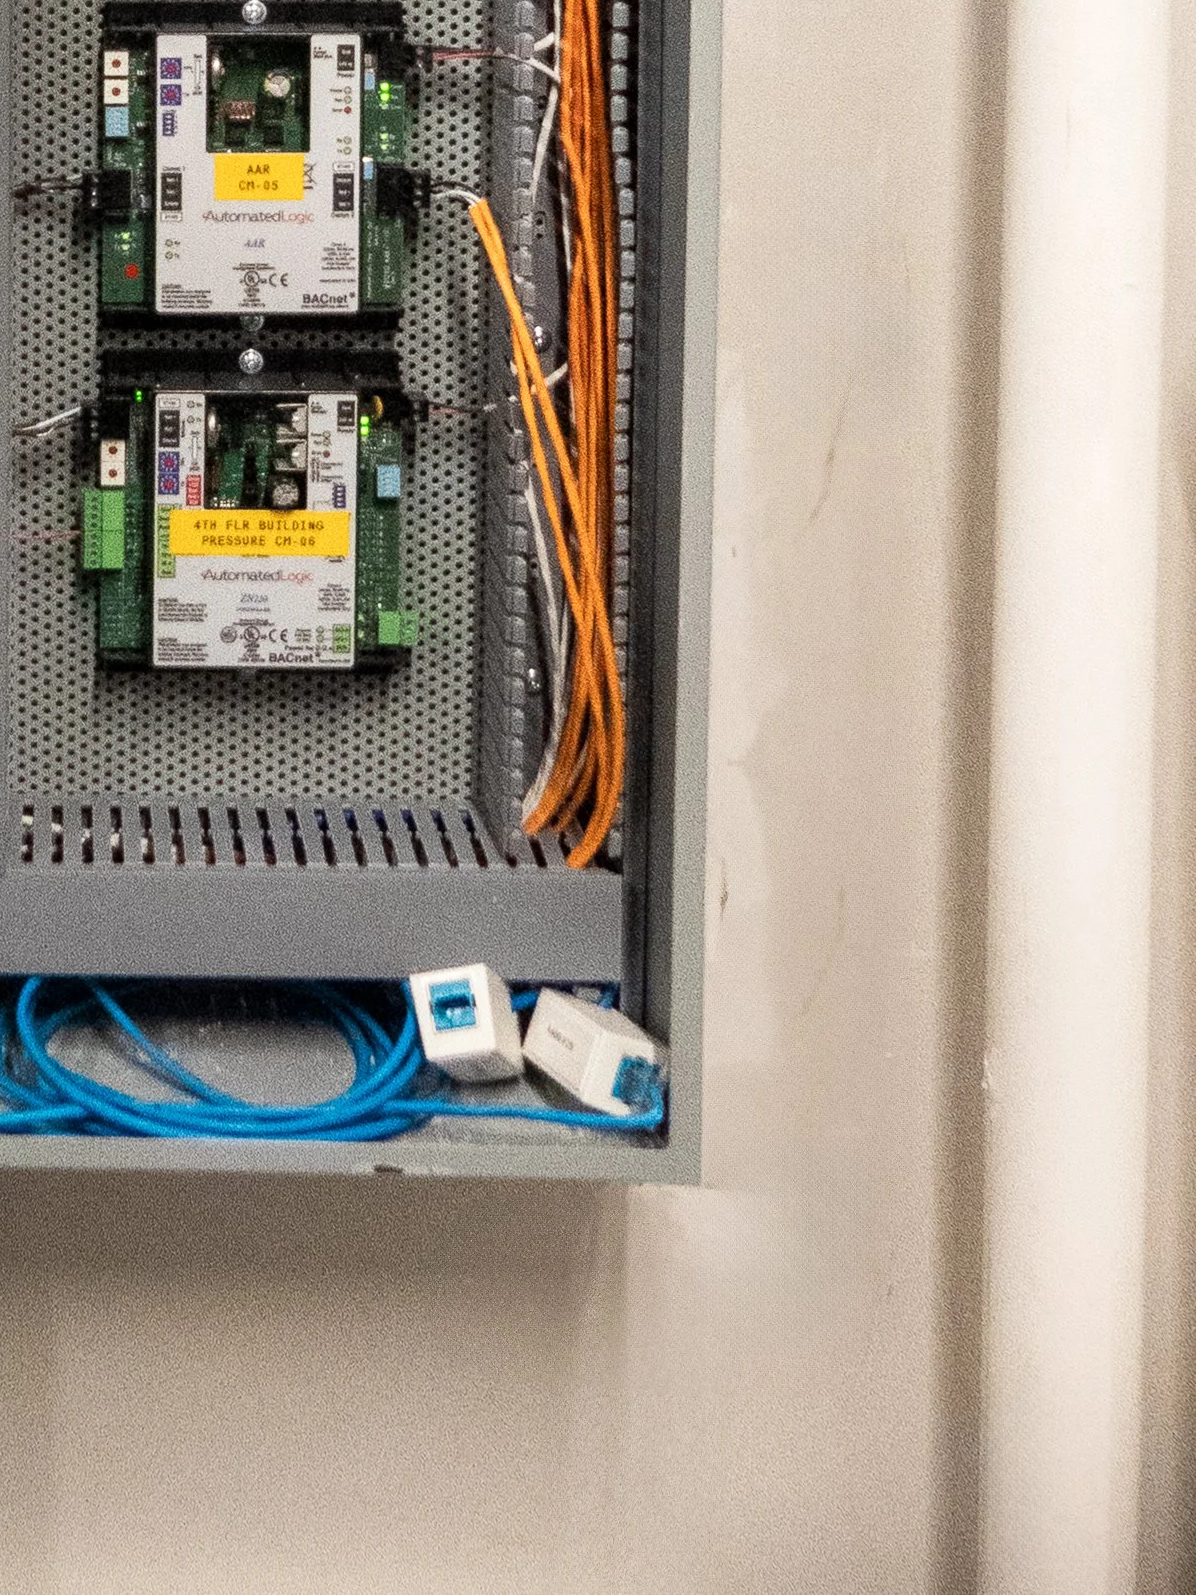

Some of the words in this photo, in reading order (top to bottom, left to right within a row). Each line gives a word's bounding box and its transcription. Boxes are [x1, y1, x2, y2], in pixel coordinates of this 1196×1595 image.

[246, 164, 271, 175] AAR
[238, 180, 279, 191] CM-05
[193, 520, 218, 531] 4TH
[225, 520, 251, 531] FLR
[258, 520, 325, 531] BUILDING
[201, 536, 266, 547] PRESSURE
[275, 535, 316, 546] CM-06
